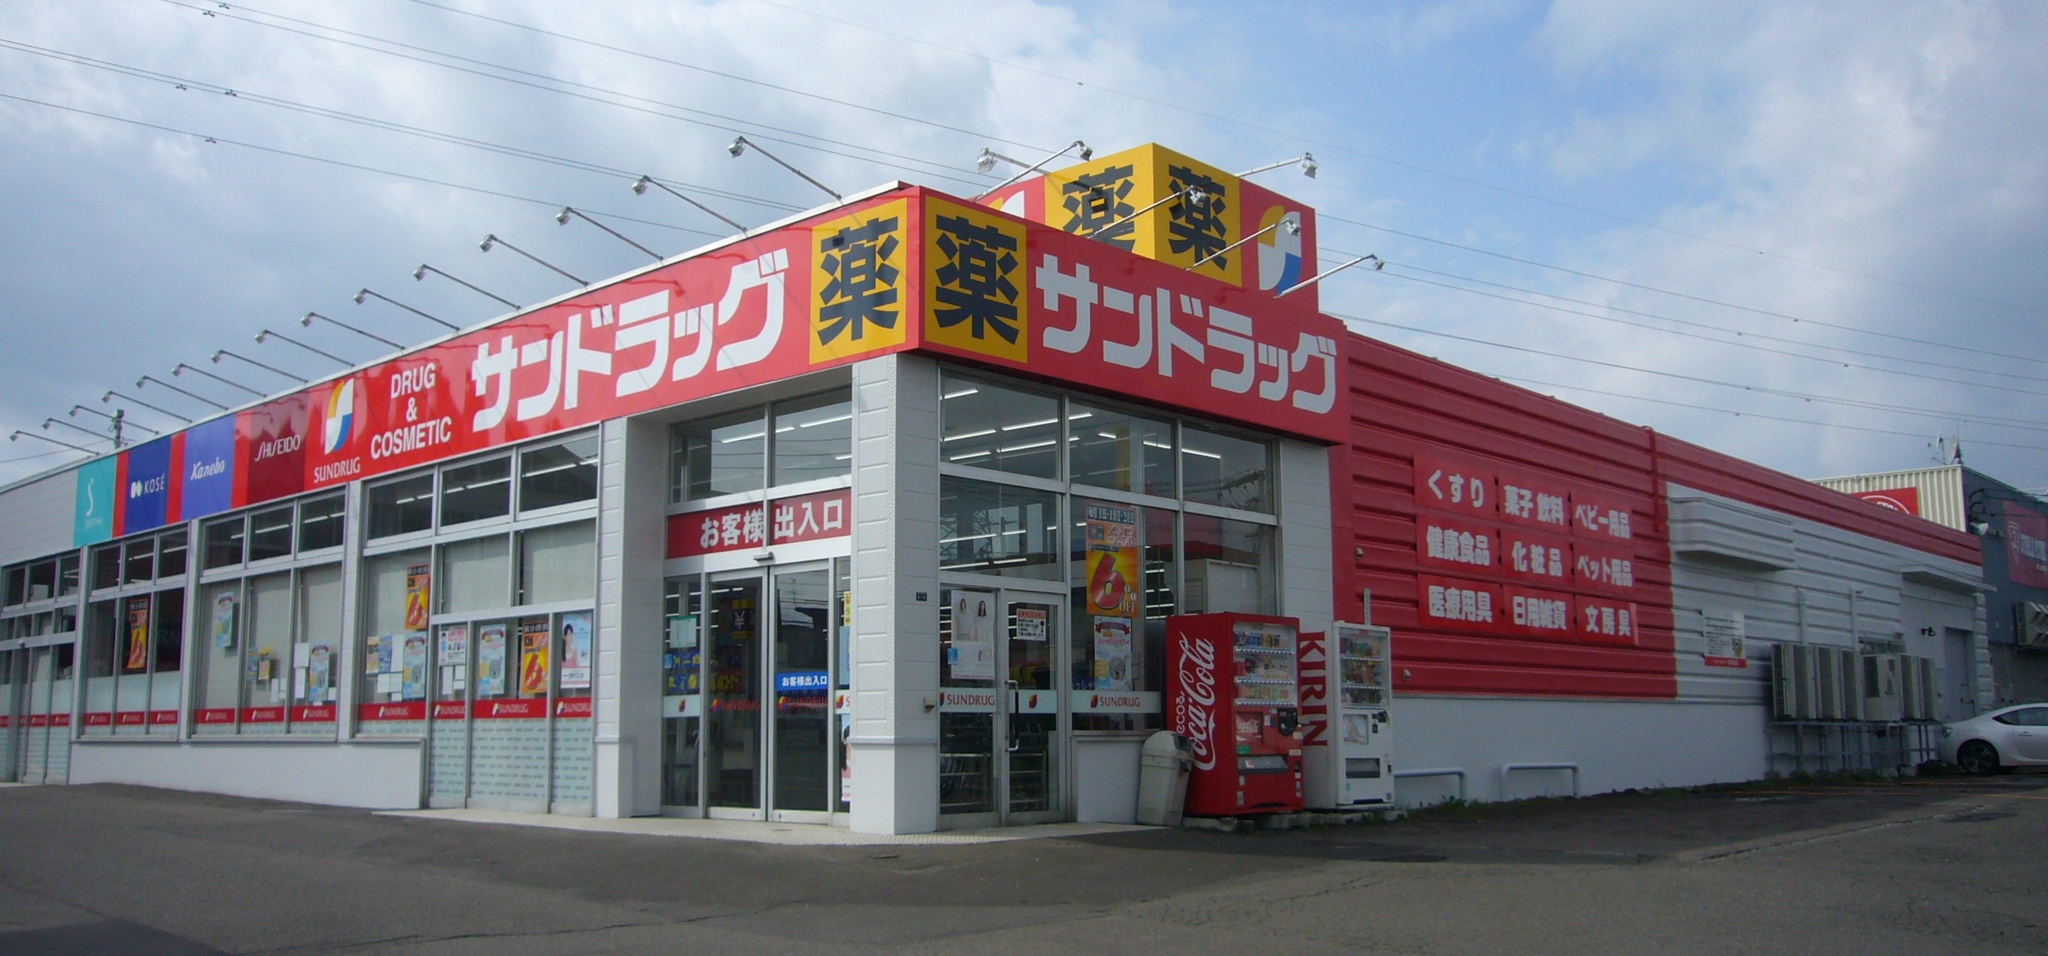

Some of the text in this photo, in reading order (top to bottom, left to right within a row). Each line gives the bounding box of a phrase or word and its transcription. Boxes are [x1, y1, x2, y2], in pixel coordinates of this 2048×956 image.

[1168, 163, 1228, 271] 薬
[471, 215, 900, 433] サンドラッグ 薬
[935, 214, 1338, 415] 薬 サンドラッグ
[390, 362, 436, 399] DRUG
[406, 401, 418, 421] &
[254, 434, 300, 462] SHISEIDO
[370, 415, 452, 461] COSMETIC
[144, 473, 165, 494] KOSÉ
[190, 456, 226, 481] Kanebo
[313, 456, 361, 484] SUNDRUG
[1428, 469, 1484, 507] くすり
[1504, 485, 1565, 526] 菓子 飲料
[700, 498, 843, 549] お客様出入口
[1575, 504, 1630, 539] ベビー用品
[1427, 525, 1490, 566] 健康食品
[1512, 541, 1562, 577] 化粧品
[1578, 555, 1633, 587] ペット用品
[1428, 585, 1492, 623] 医療用具
[1513, 596, 1567, 630] 日用雑貨
[1585, 605, 1631, 637] 文房具
[782, 675, 828, 687] お客様出入口
[1300, 631, 1328, 747] KIRIN
[499, 703, 529, 713] SUNDRUG
[946, 694, 996, 706] SUNDRUG
[1099, 696, 1141, 707] SUNDRUG
